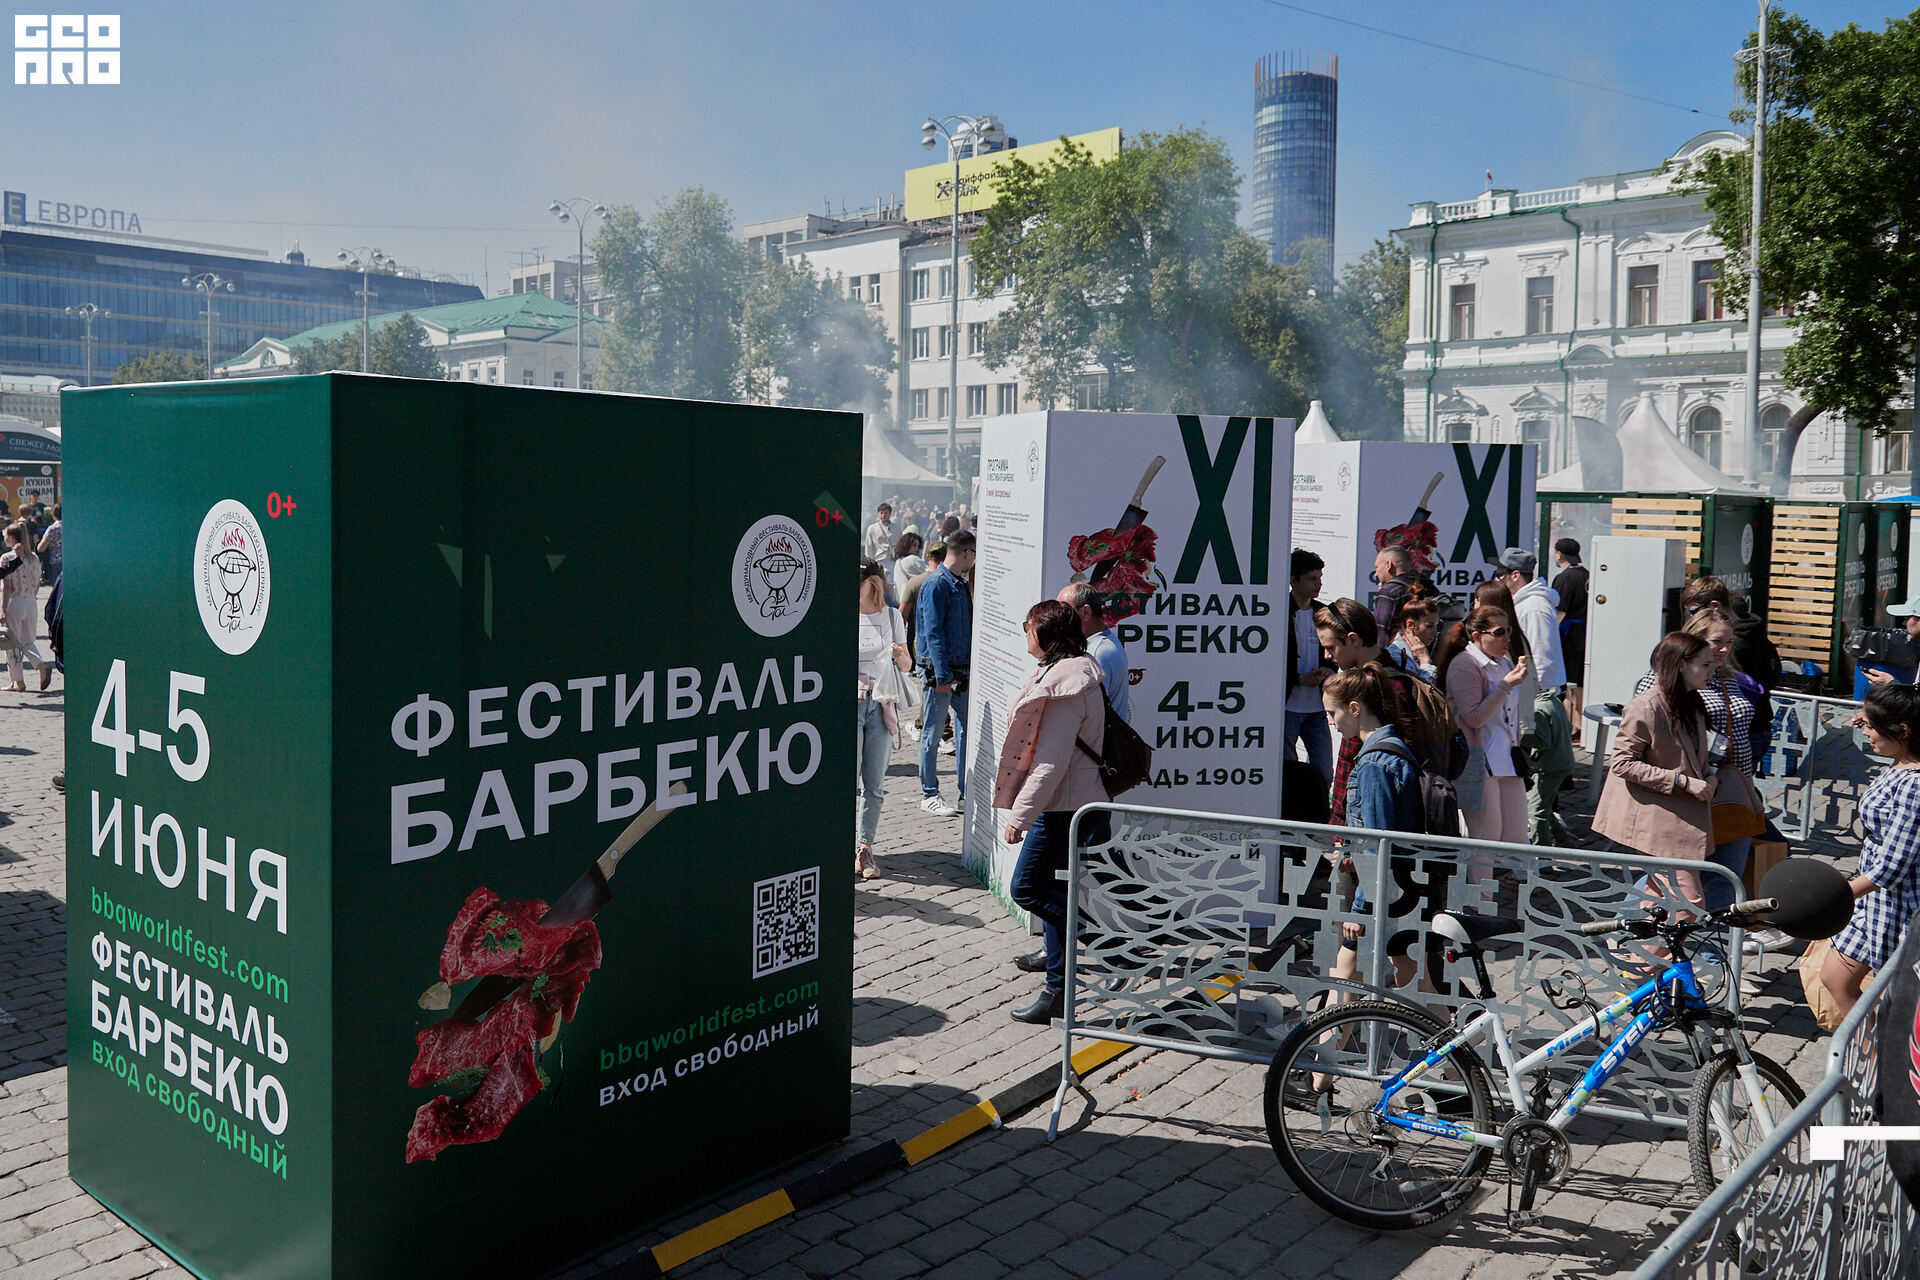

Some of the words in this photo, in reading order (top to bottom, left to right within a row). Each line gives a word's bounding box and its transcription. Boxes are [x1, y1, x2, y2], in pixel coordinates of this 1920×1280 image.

[38, 199, 142, 234] ЕВРОПА
[25, 479, 51, 487] КУХНЯ
[266, 491, 297, 519] 0+
[1173, 415, 1274, 585] XI
[1450, 443, 1523, 563] XI
[815, 507, 844, 527] 0+
[1097, 593, 1271, 617] ЕСТИВАЛЬ
[1118, 624, 1269, 654] РБЕКЮ
[91, 658, 211, 782] 4-5
[390, 655, 824, 758] ФЕСТИВАЛЬ
[1157, 681, 1246, 721] 4-5
[1156, 726, 1265, 748] ИЮНЯ
[390, 720, 823, 865] БАРБЕКЮ
[1195, 768, 1264, 785] 1905
[91, 789, 287, 934] ИЮНЯ
[91, 886, 289, 1004] bbqworldfest.com
[91, 931, 289, 1065] ФЕСТИВАЛЬ
[600, 980, 819, 1071] bbqworldfest.com
[91, 979, 289, 1136] БАРБЕКЮ
[1546, 1023, 1595, 1059] Miss
